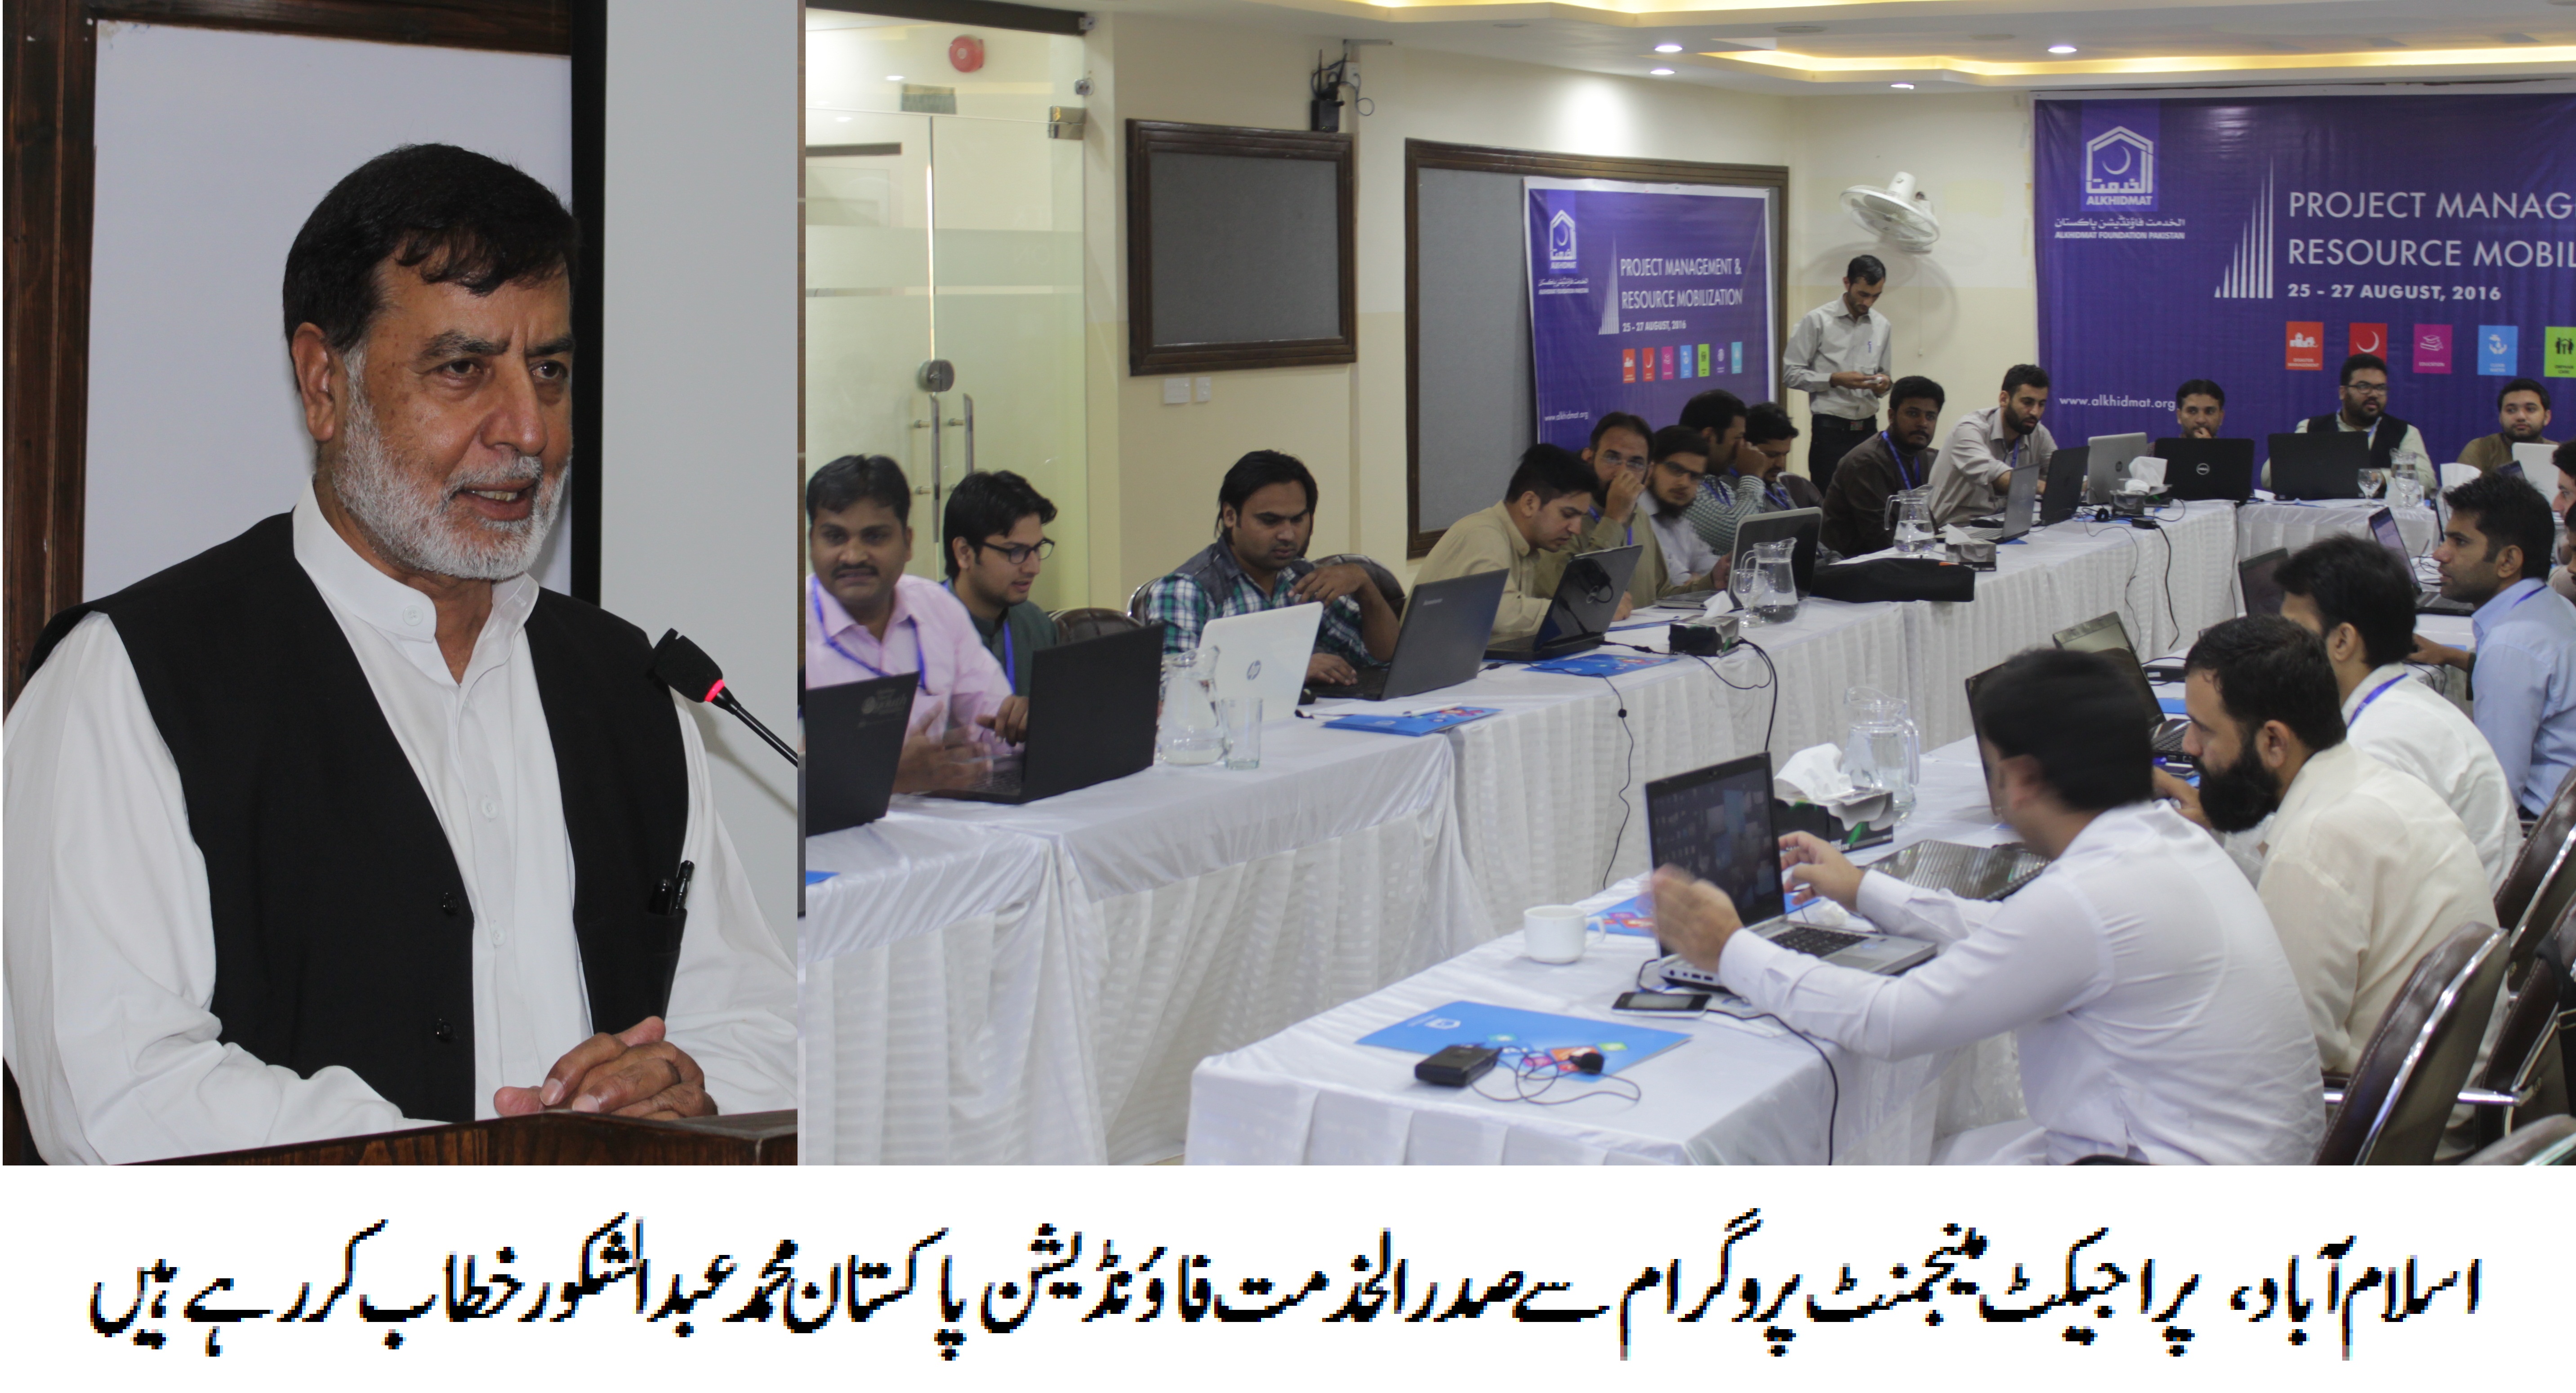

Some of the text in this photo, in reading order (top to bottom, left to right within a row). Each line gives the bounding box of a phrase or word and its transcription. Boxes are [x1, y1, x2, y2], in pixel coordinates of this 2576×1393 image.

[2086, 196, 2153, 205] ALKHIDMAT
[2290, 192, 2576, 219] PROJECT MANAG
[2288, 239, 2462, 266] RESOURCE
[1620, 258, 1742, 276] PROJECT MANAGEMENT &
[1622, 289, 1743, 309] RESOURCE MOBILIZATION
[2287, 284, 2310, 297] 25
[2331, 285, 2354, 297] 27
[2360, 285, 2446, 301] AUGUST,
[2452, 286, 2501, 300] 2016
[1622, 322, 1631, 332] 25
[1636, 322, 1644, 331] 27
[2059, 394, 2176, 411] www.alkhidmat.org
